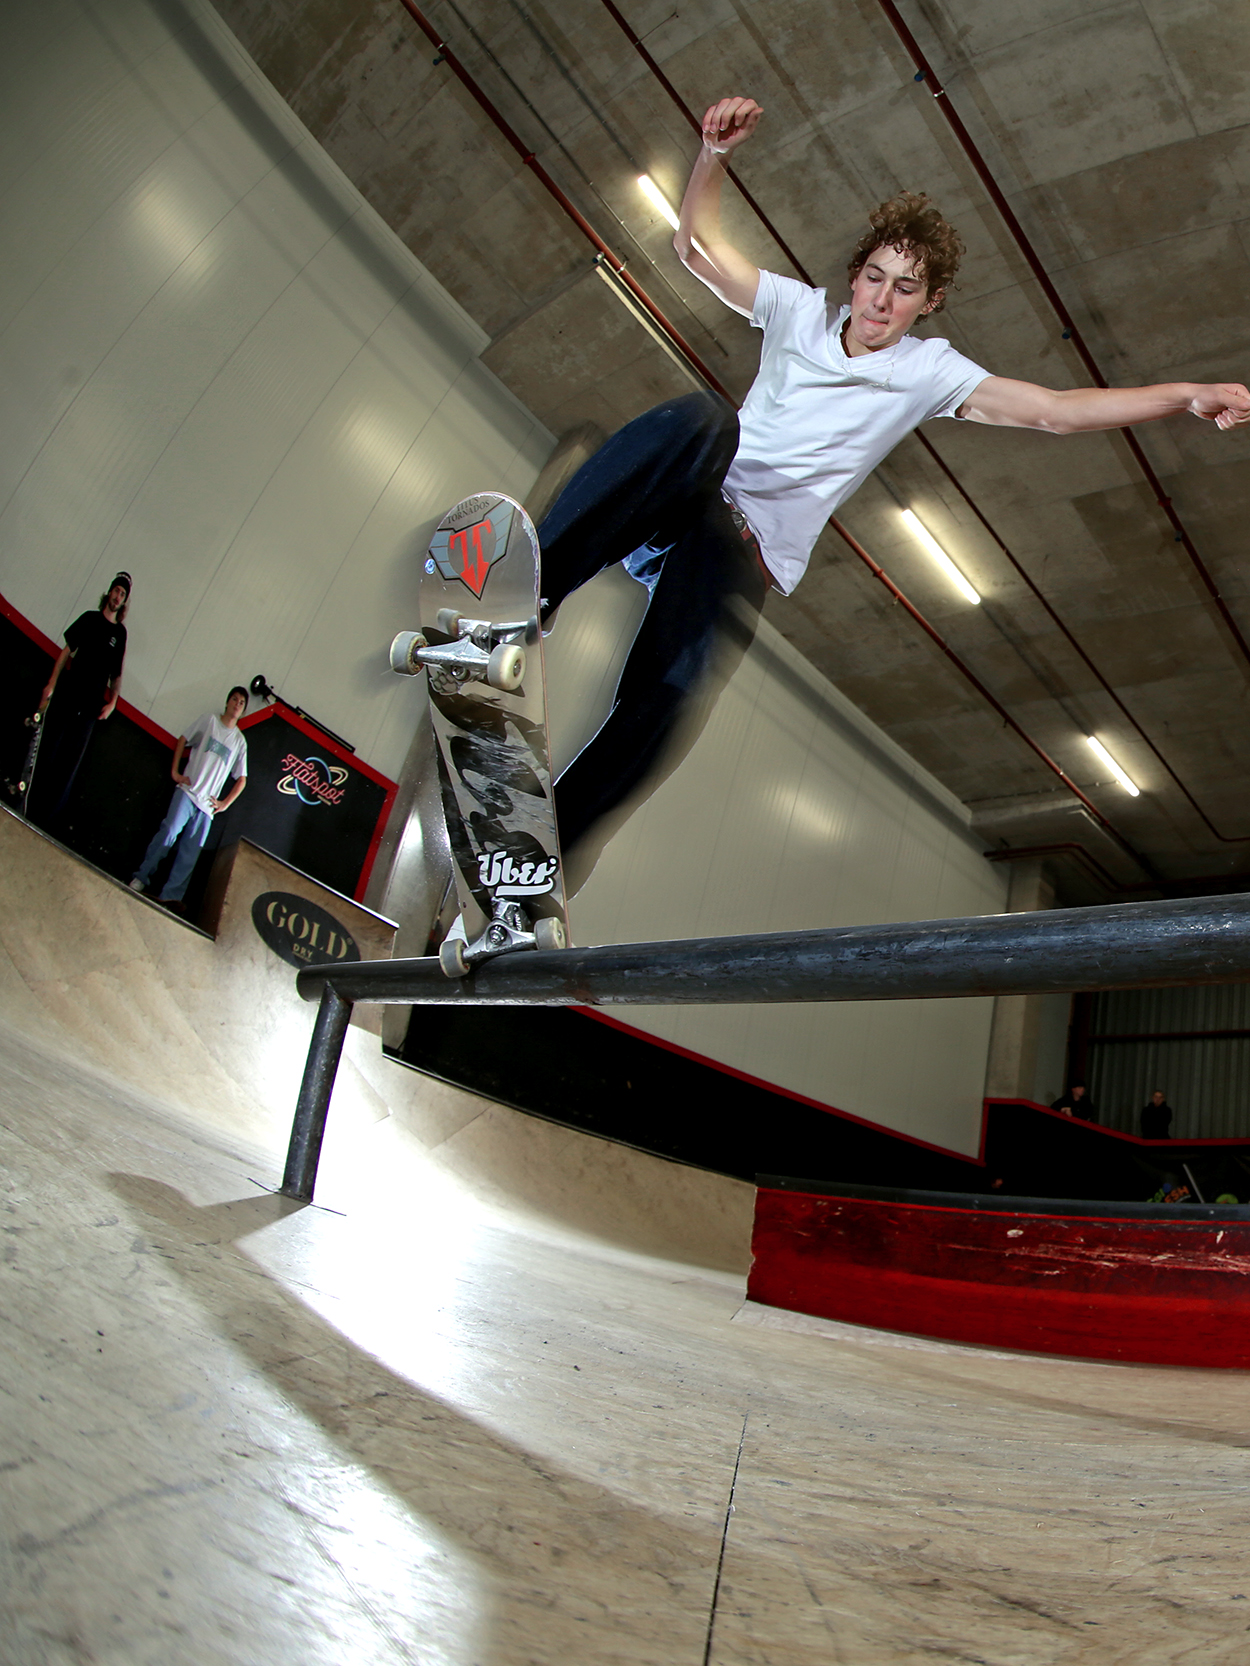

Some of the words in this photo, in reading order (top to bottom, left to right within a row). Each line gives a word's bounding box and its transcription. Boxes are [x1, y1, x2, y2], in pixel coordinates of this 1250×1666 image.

[447, 500, 490, 524] TORNADOS
[456, 496, 480, 511] TITUS
[281, 754, 345, 804] Flatspot
[266, 901, 348, 959] GOLD
[292, 943, 313, 959] DRY
